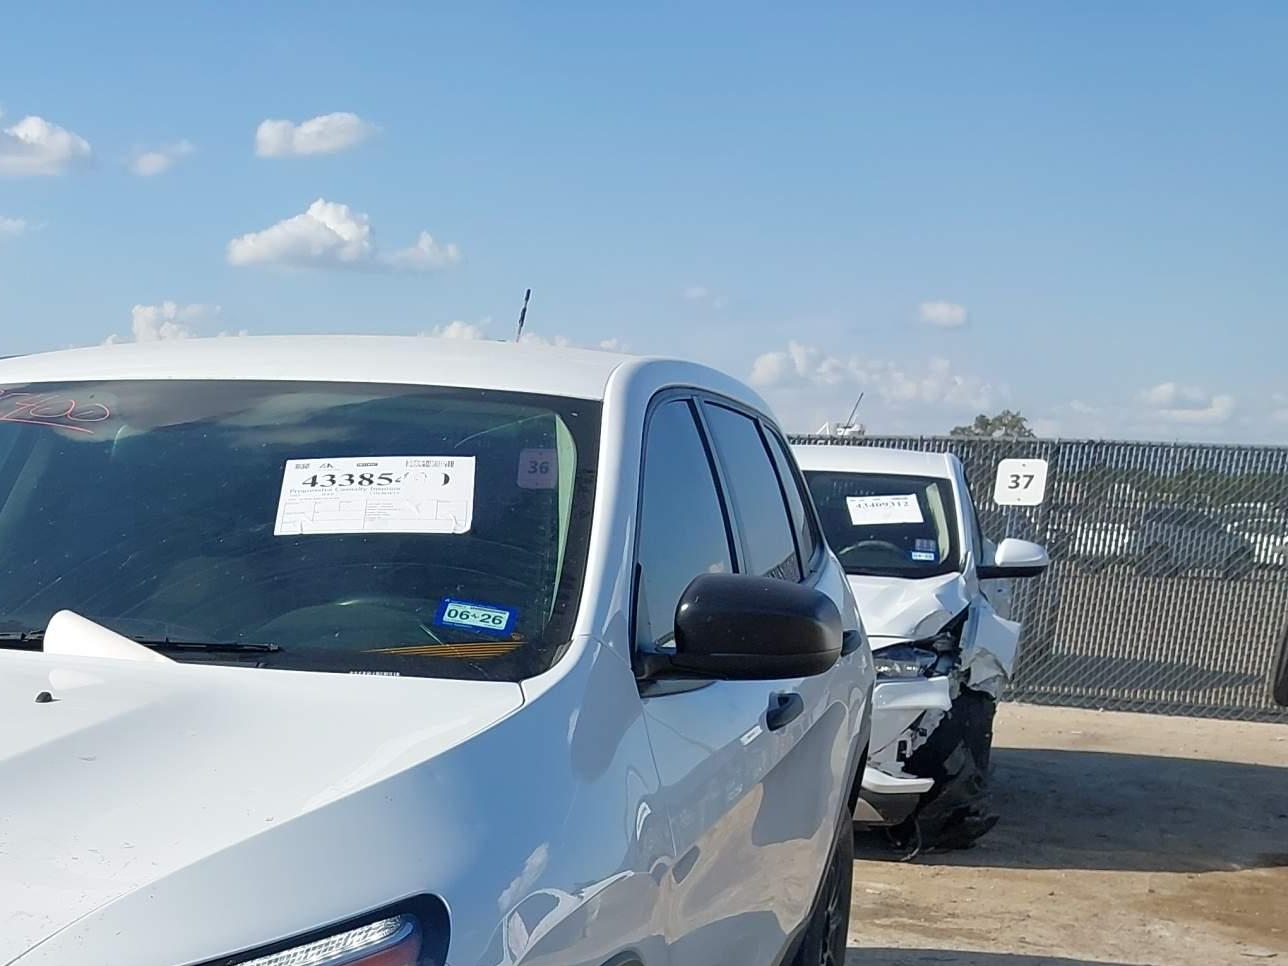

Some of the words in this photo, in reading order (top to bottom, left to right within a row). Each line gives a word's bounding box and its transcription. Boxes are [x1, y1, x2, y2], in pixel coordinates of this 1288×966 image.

[527, 460, 549, 474] 36
[302, 472, 450, 488] 43385
[1008, 474, 1034, 489] 37
[447, 608, 470, 620] 06
[479, 613, 504, 625] 26
